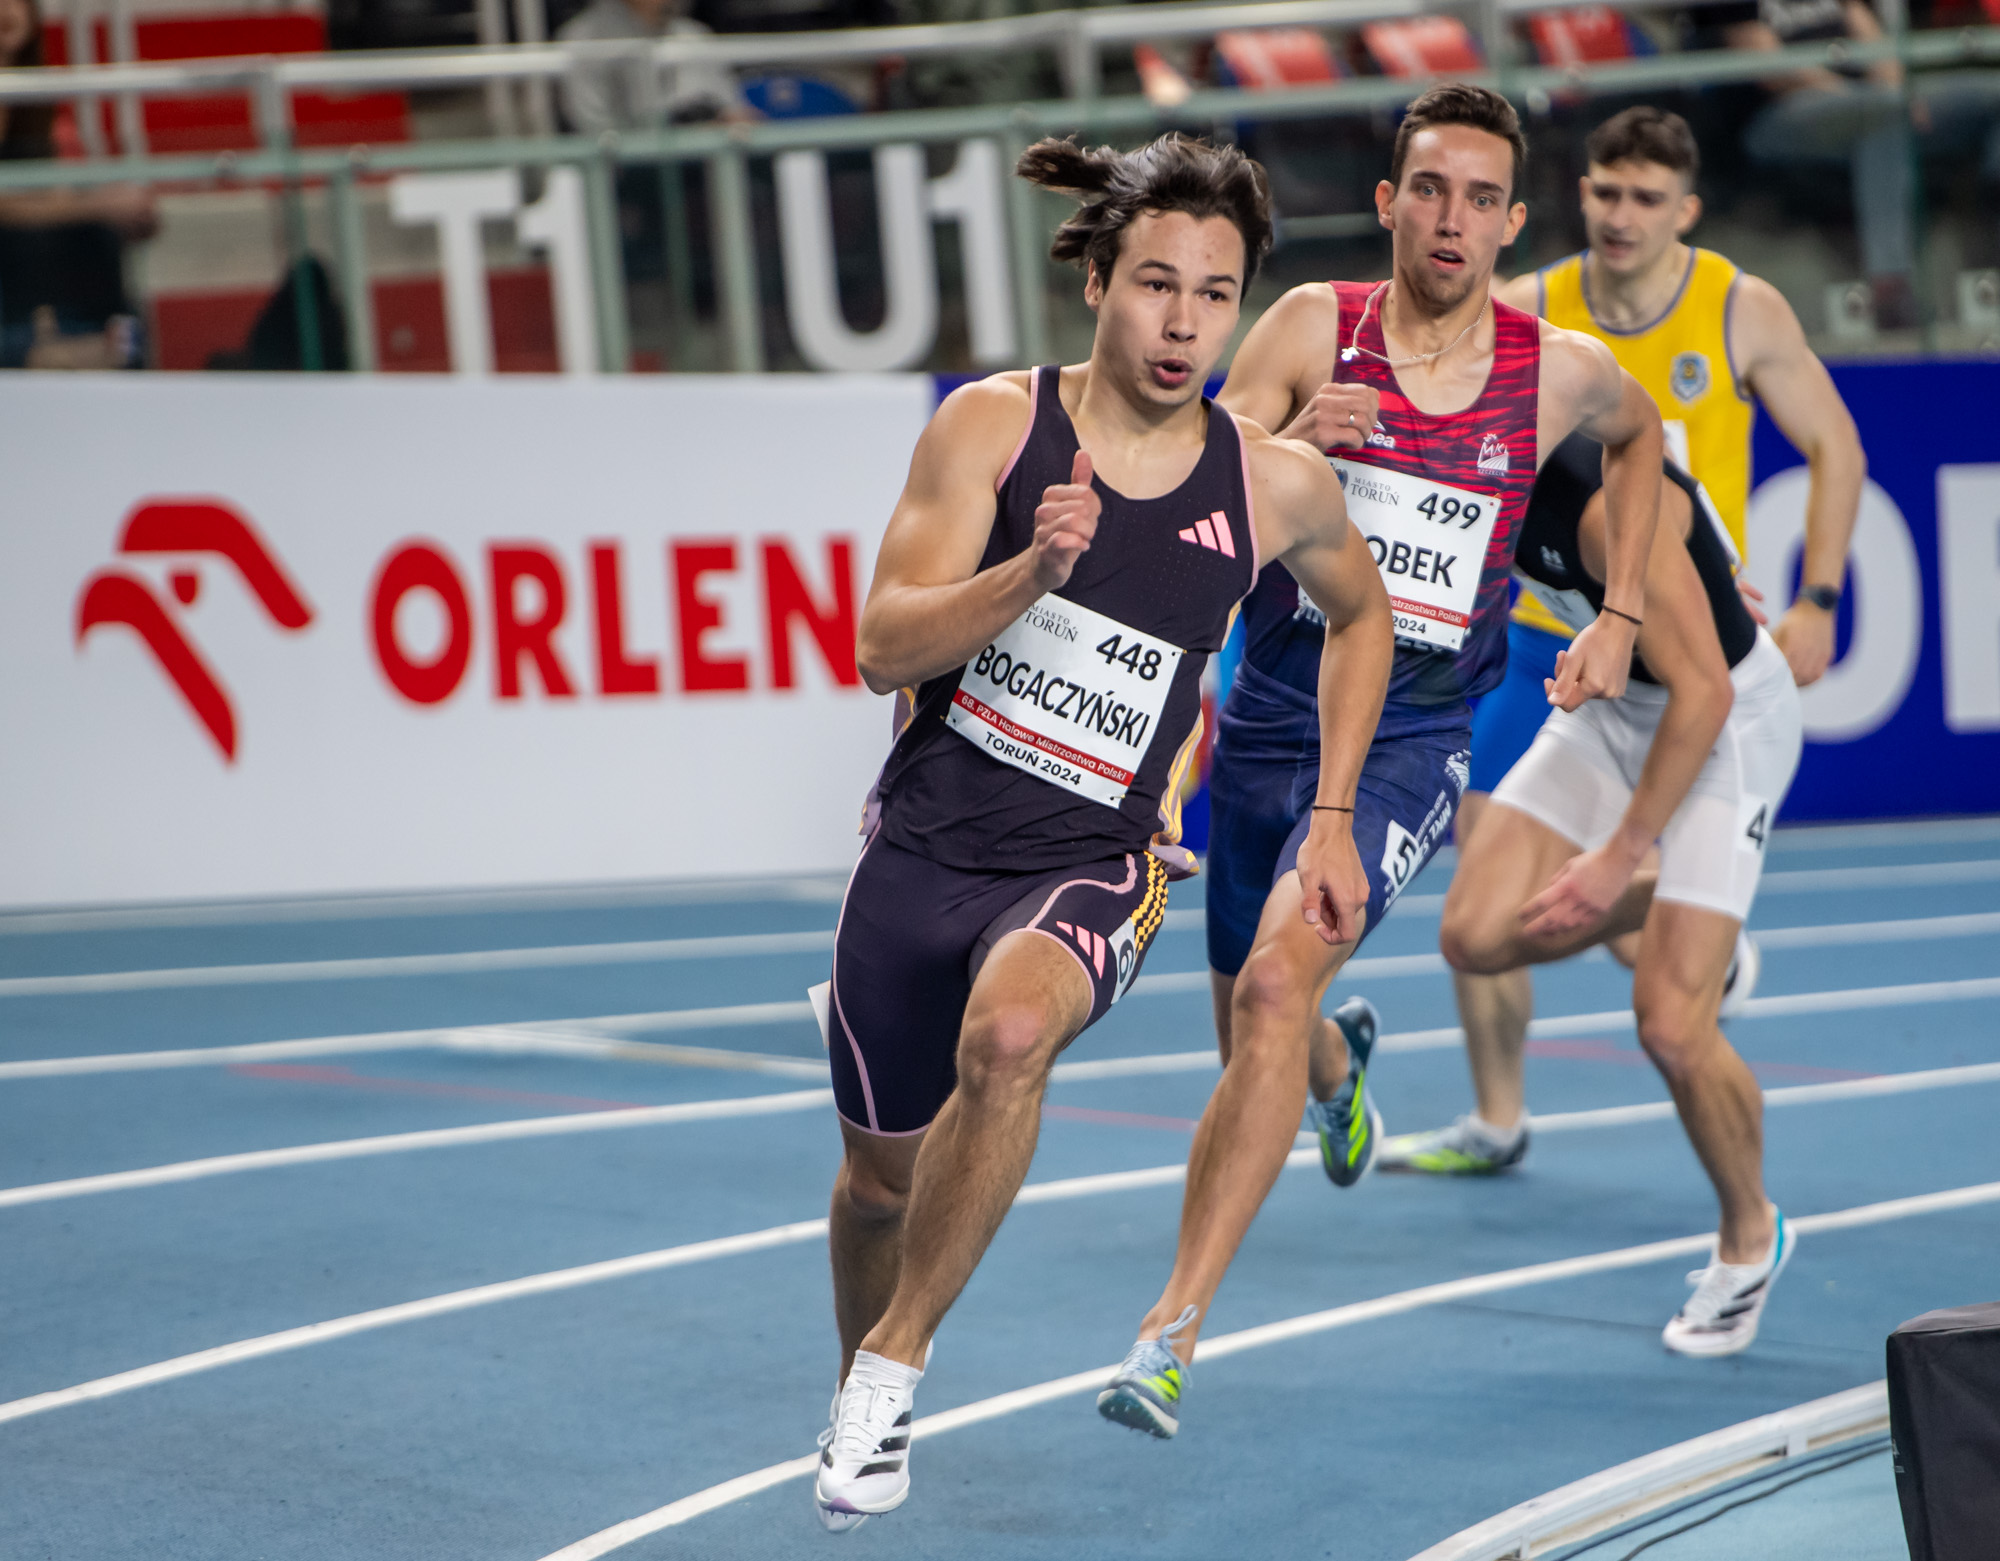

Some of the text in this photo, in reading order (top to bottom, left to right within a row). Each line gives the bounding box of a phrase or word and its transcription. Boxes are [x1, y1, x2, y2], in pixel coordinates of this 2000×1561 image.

[774, 141, 1018, 373] U1
[1350, 482, 1400, 507] TORUŃ
[1354, 476, 1391, 492] MIASTO
[1416, 492, 1481, 529] 499
[1364, 534, 1458, 589] OBEK
[368, 533, 862, 709] ORLEN
[1025, 610, 1079, 642] TORUŃ
[1031, 603, 1070, 625] MIASTO
[1389, 595, 1462, 624] istrzostwa Polski
[1391, 614, 1427, 634] 2024
[1096, 633, 1162, 681] 448
[973, 643, 1150, 748] BOGACZYŃSKI
[961, 695, 1127, 782] 68. PZLA Halowe Mistrzostwa Polski
[985, 730, 1082, 785] TORUŃ 2024
[1746, 802, 1767, 850] 4
[1393, 834, 1417, 886] 5
[1119, 938, 1134, 984] 6
